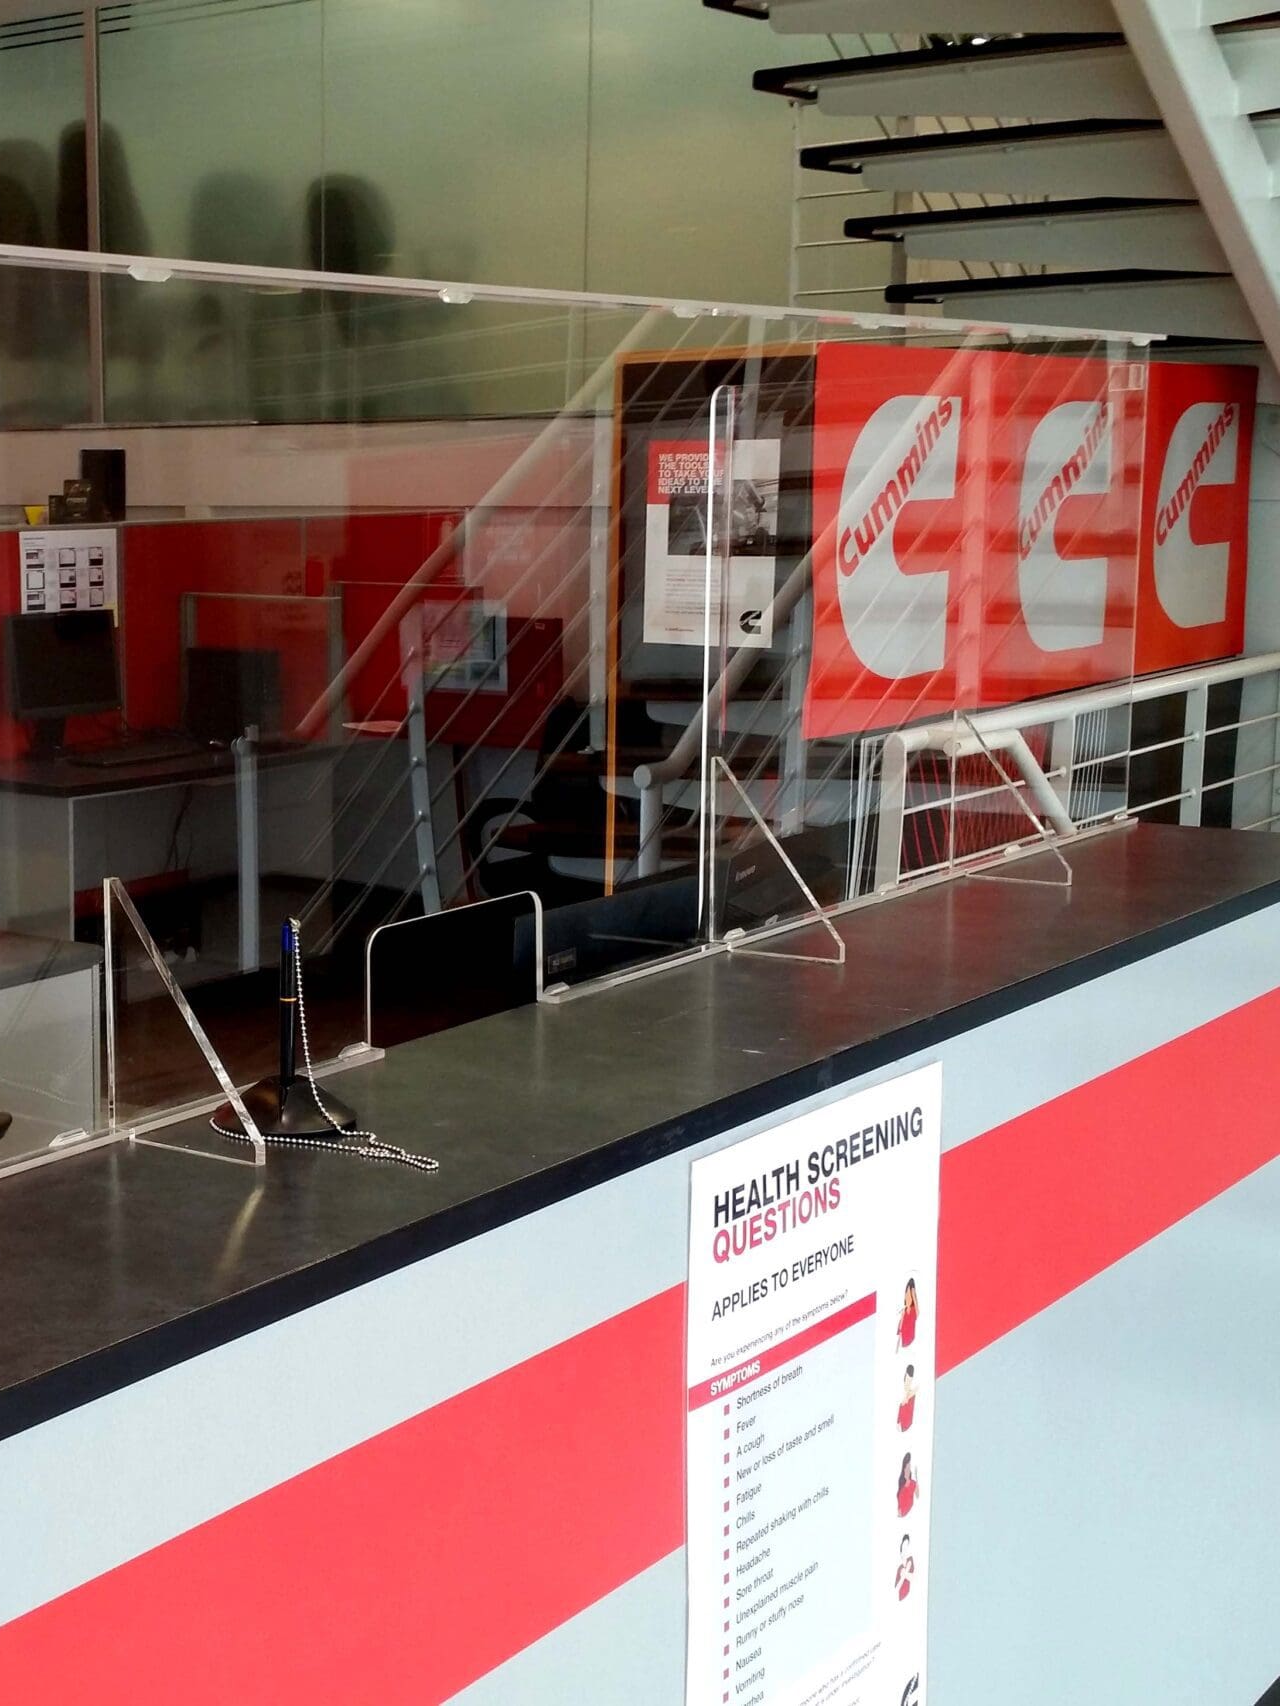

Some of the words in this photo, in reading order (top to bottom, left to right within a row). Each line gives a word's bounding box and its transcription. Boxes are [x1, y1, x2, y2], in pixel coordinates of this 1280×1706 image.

[658, 462, 676, 470] THE
[658, 470, 671, 478] TO
[674, 470, 697, 478] TAKE
[675, 453, 709, 462] PROVID
[1155, 401, 1234, 547] Cummins
[658, 478, 686, 486] IDEAS
[688, 478, 700, 486] TO
[702, 478, 723, 486] TE
[658, 486, 682, 494] NEXT
[684, 486, 709, 494] LEVE
[838, 397, 953, 578] Cummins
[1020, 400, 1108, 561] Cummins
[714, 1159, 800, 1228] HEALTH
[807, 1106, 923, 1185] SCREENING
[713, 1177, 841, 1264] QUESTIONS
[712, 1277, 768, 1322] APPLIES
[771, 1268, 788, 1292] TO
[792, 1234, 854, 1284] EVERYONE
[710, 1357, 722, 1367] Are
[724, 1351, 735, 1363] you
[736, 1331, 774, 1356] experiencing
[774, 1326, 784, 1336] any
[785, 1320, 792, 1330] of
[792, 1316, 802, 1326] the
[802, 1301, 829, 1323] symptoms
[710, 1360, 761, 1396] SYMPTOMS
[736, 1383, 772, 1410] Shortness
[772, 1376, 780, 1390] of
[781, 1366, 803, 1385] breath
[736, 1416, 756, 1434] Fever
[736, 1446, 742, 1458] A
[743, 1432, 765, 1454] cough
[736, 1466, 752, 1482] New
[753, 1460, 762, 1472] or
[762, 1451, 776, 1465] loss
[777, 1442, 784, 1456] of
[785, 1435, 802, 1452] taste
[803, 1424, 817, 1442] and
[817, 1413, 835, 1433] smell
[736, 1483, 762, 1506] Fatigue
[736, 1510, 756, 1529] Chills
[736, 1522, 770, 1554] Repeated
[770, 1508, 796, 1531] shaking
[798, 1498, 812, 1513] with
[812, 1486, 830, 1504] chills
[736, 1548, 770, 1576] Headache
[736, 1583, 753, 1601] Sore
[754, 1568, 774, 1588] throat
[736, 1586, 778, 1624] Unexplained
[780, 1570, 804, 1594] muscle
[804, 1561, 819, 1580] pain
[736, 1626, 758, 1648] Runny
[759, 1620, 767, 1632] or
[768, 1605, 788, 1626] stuffy
[788, 1594, 804, 1612] nose
[736, 1647, 762, 1672] Nausea
[736, 1666, 766, 1694] Vomiting
